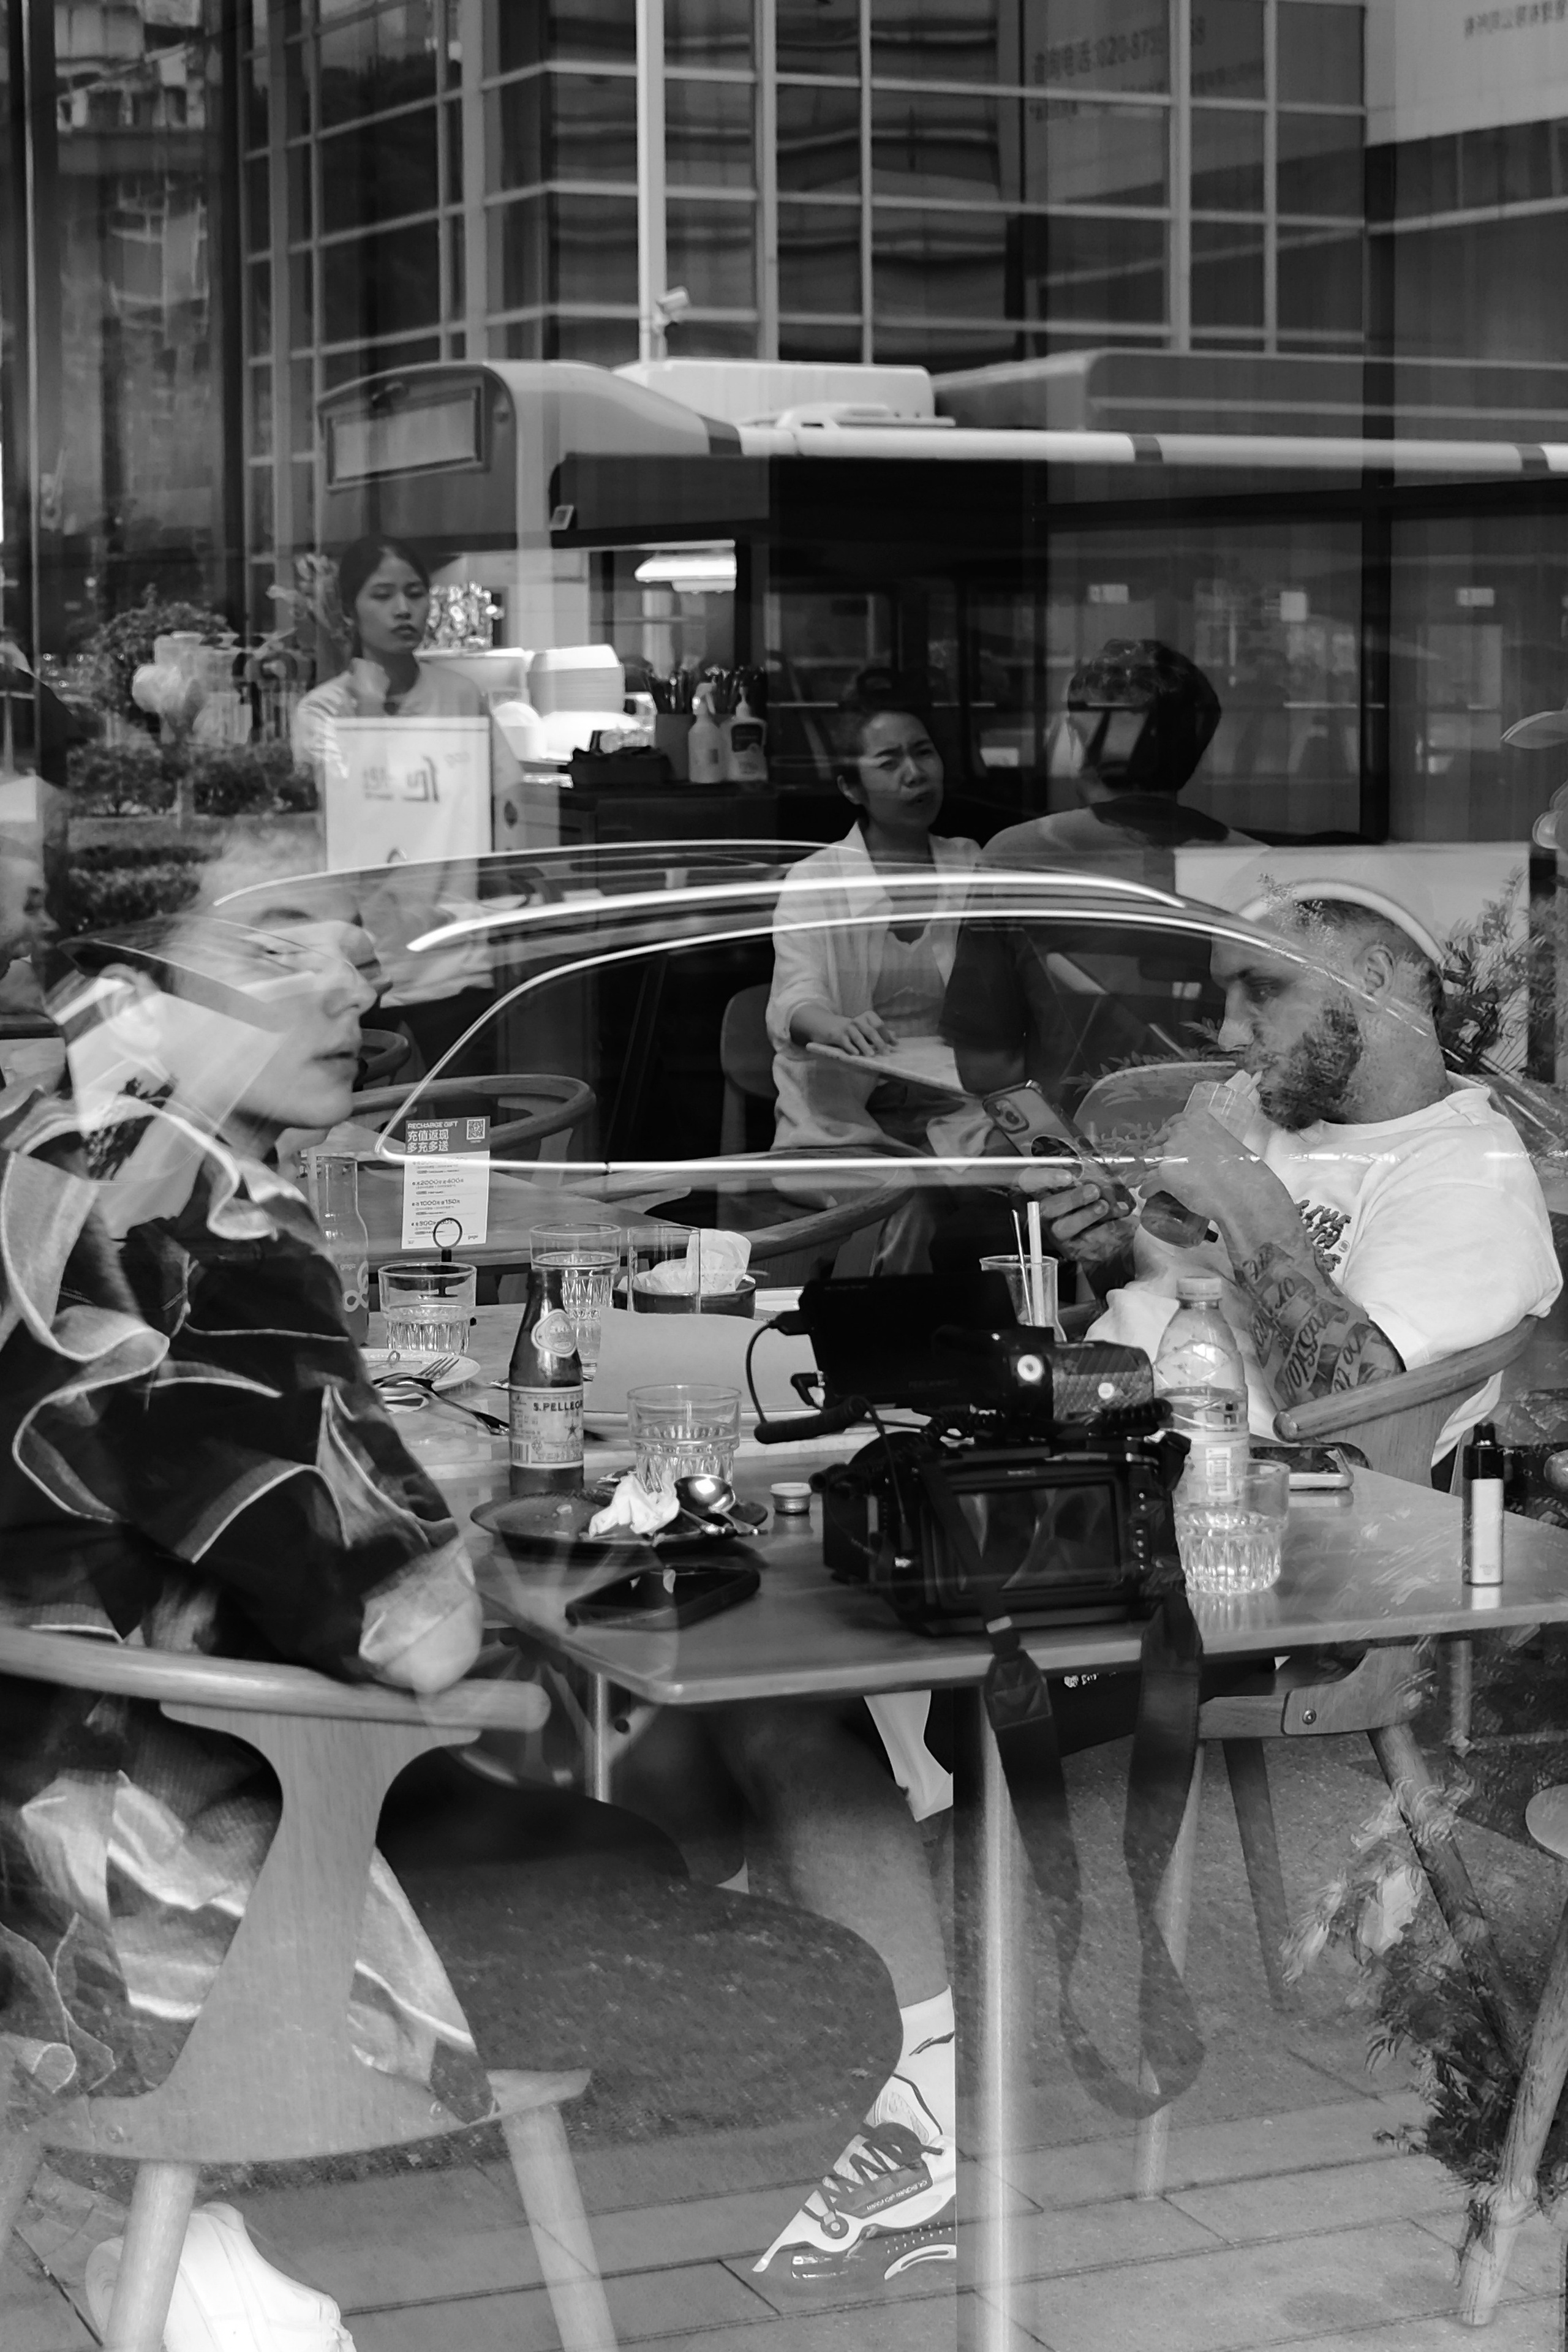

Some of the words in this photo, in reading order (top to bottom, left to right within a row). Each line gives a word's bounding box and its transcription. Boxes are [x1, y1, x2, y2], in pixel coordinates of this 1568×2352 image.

[407, 1129, 449, 1142] 充值返现
[407, 1140, 449, 1153] 多充多送
